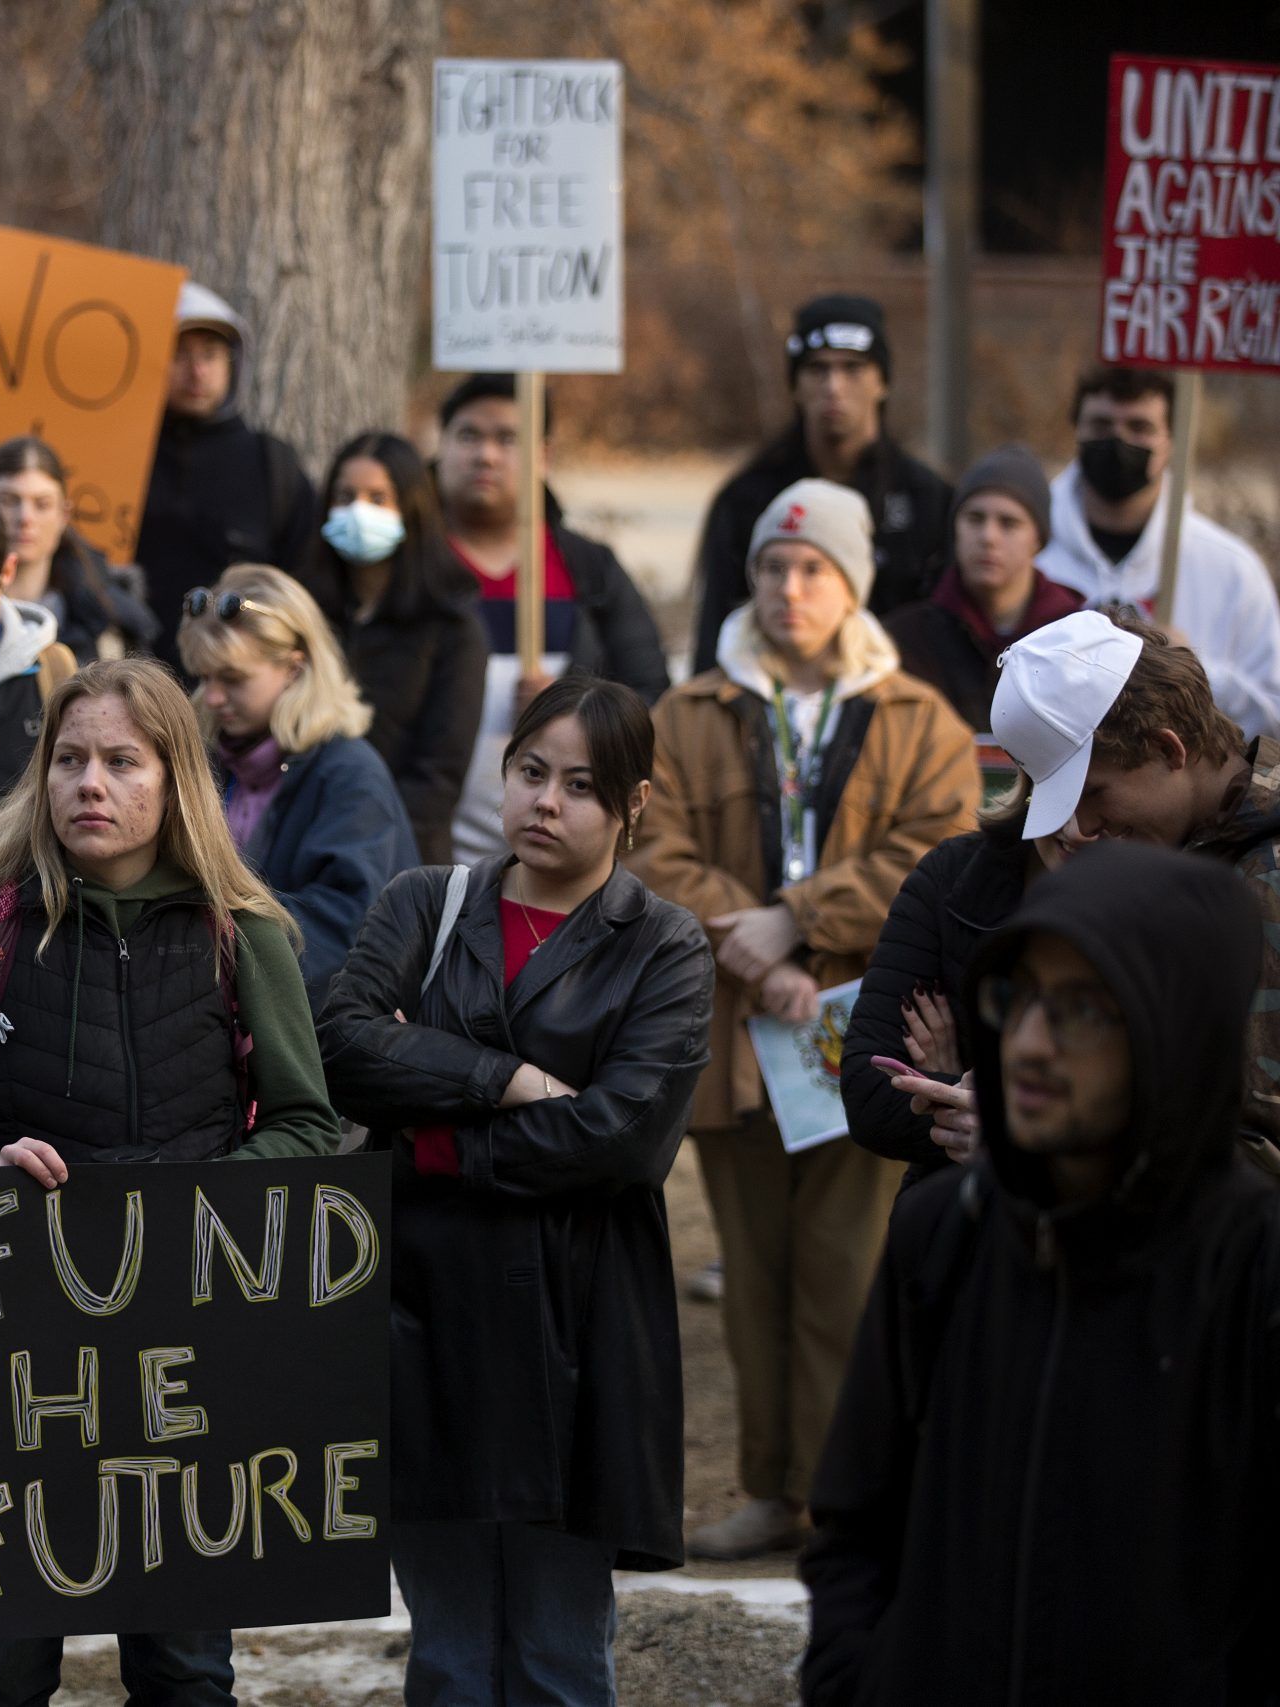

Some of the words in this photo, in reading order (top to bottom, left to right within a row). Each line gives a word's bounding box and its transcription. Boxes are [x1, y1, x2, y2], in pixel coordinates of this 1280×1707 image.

[493, 132, 552, 168] FOR
[463, 170, 589, 233] FREE
[436, 241, 613, 314] TUITION
[1115, 233, 1199, 286] THE
[1102, 277, 1191, 362] FAR
